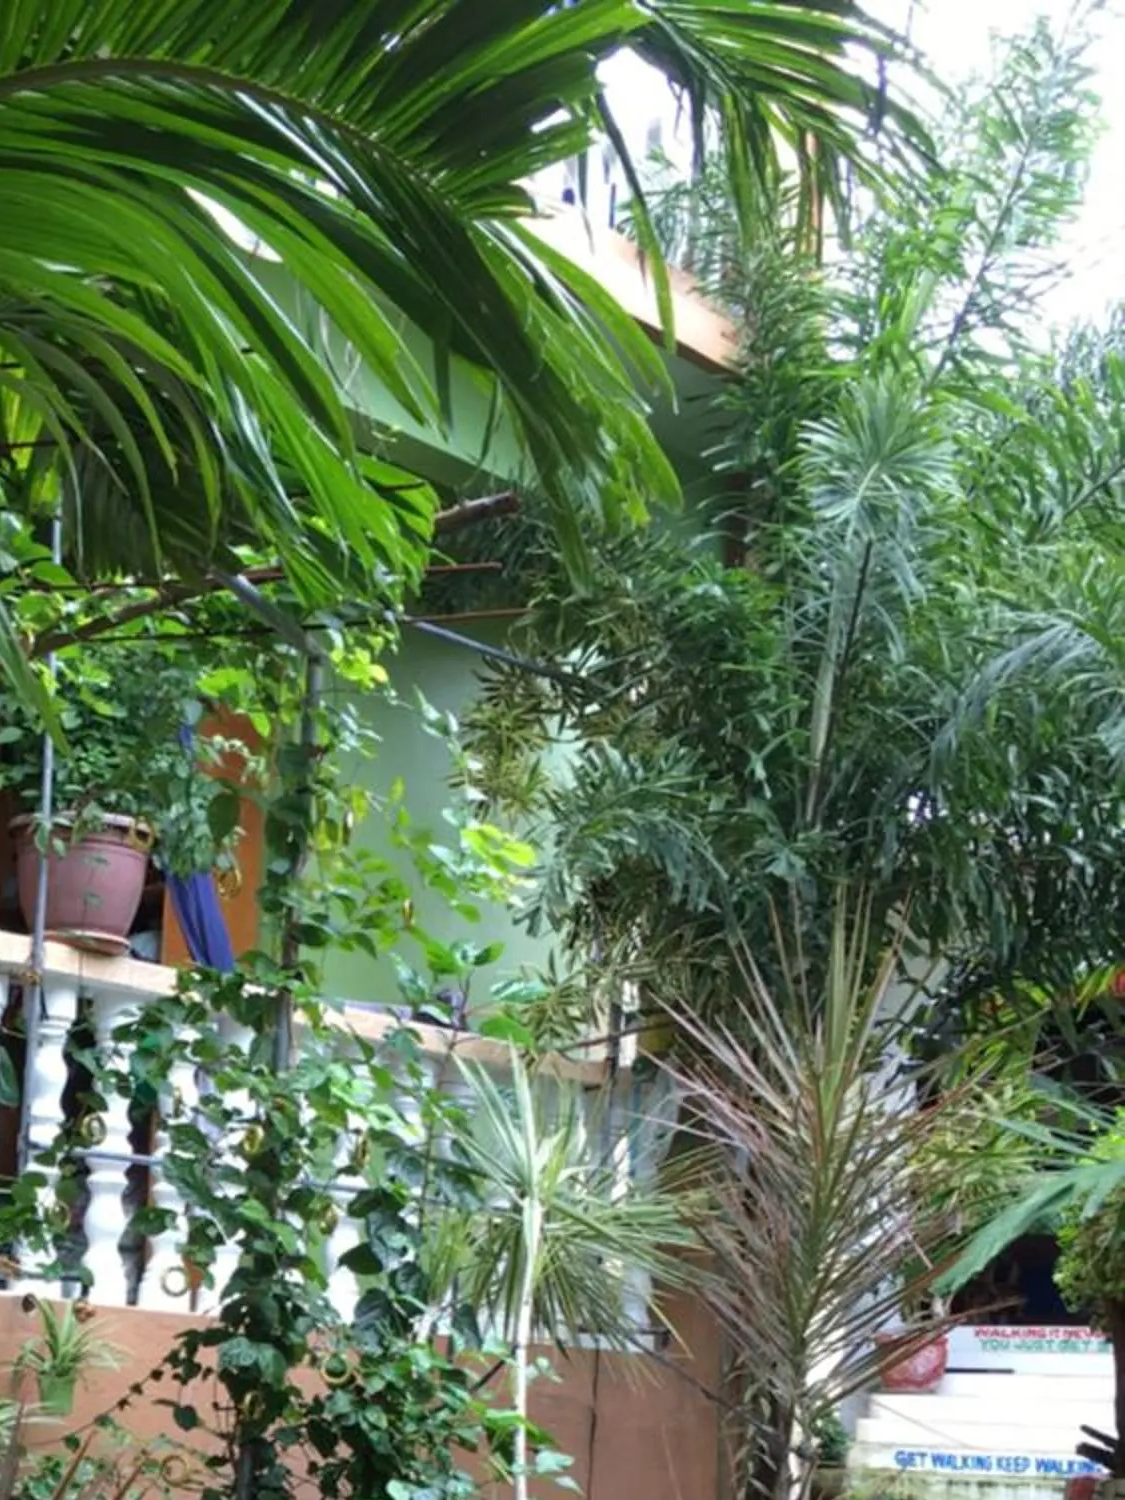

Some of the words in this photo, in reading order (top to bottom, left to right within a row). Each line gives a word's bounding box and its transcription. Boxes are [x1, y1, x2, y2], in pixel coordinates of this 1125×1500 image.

[894, 1450, 927, 1468] GET
[931, 1451, 992, 1472] WALKING
[996, 1455, 1031, 1473] KEEP
